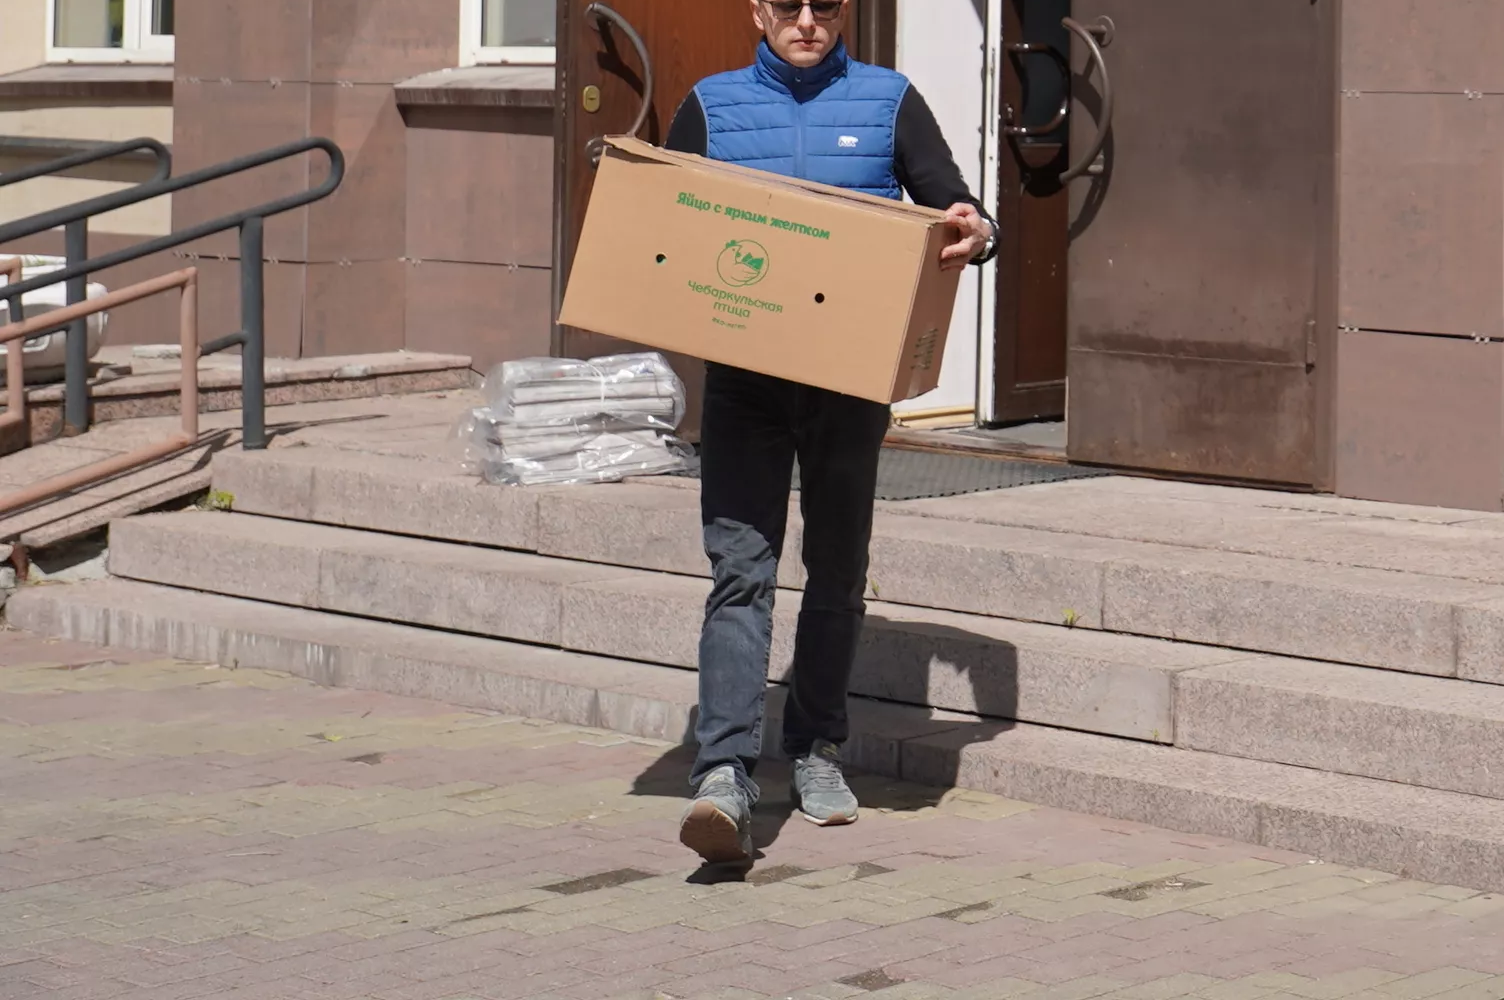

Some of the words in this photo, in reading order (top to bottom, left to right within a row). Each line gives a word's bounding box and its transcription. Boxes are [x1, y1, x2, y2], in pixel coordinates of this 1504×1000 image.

[677, 191, 711, 212] Яйцо
[714, 204, 722, 213] с
[724, 206, 767, 224] ярким
[770, 217, 830, 240] желтком
[688, 280, 783, 313] Чебаркульская
[713, 301, 751, 318] птица
